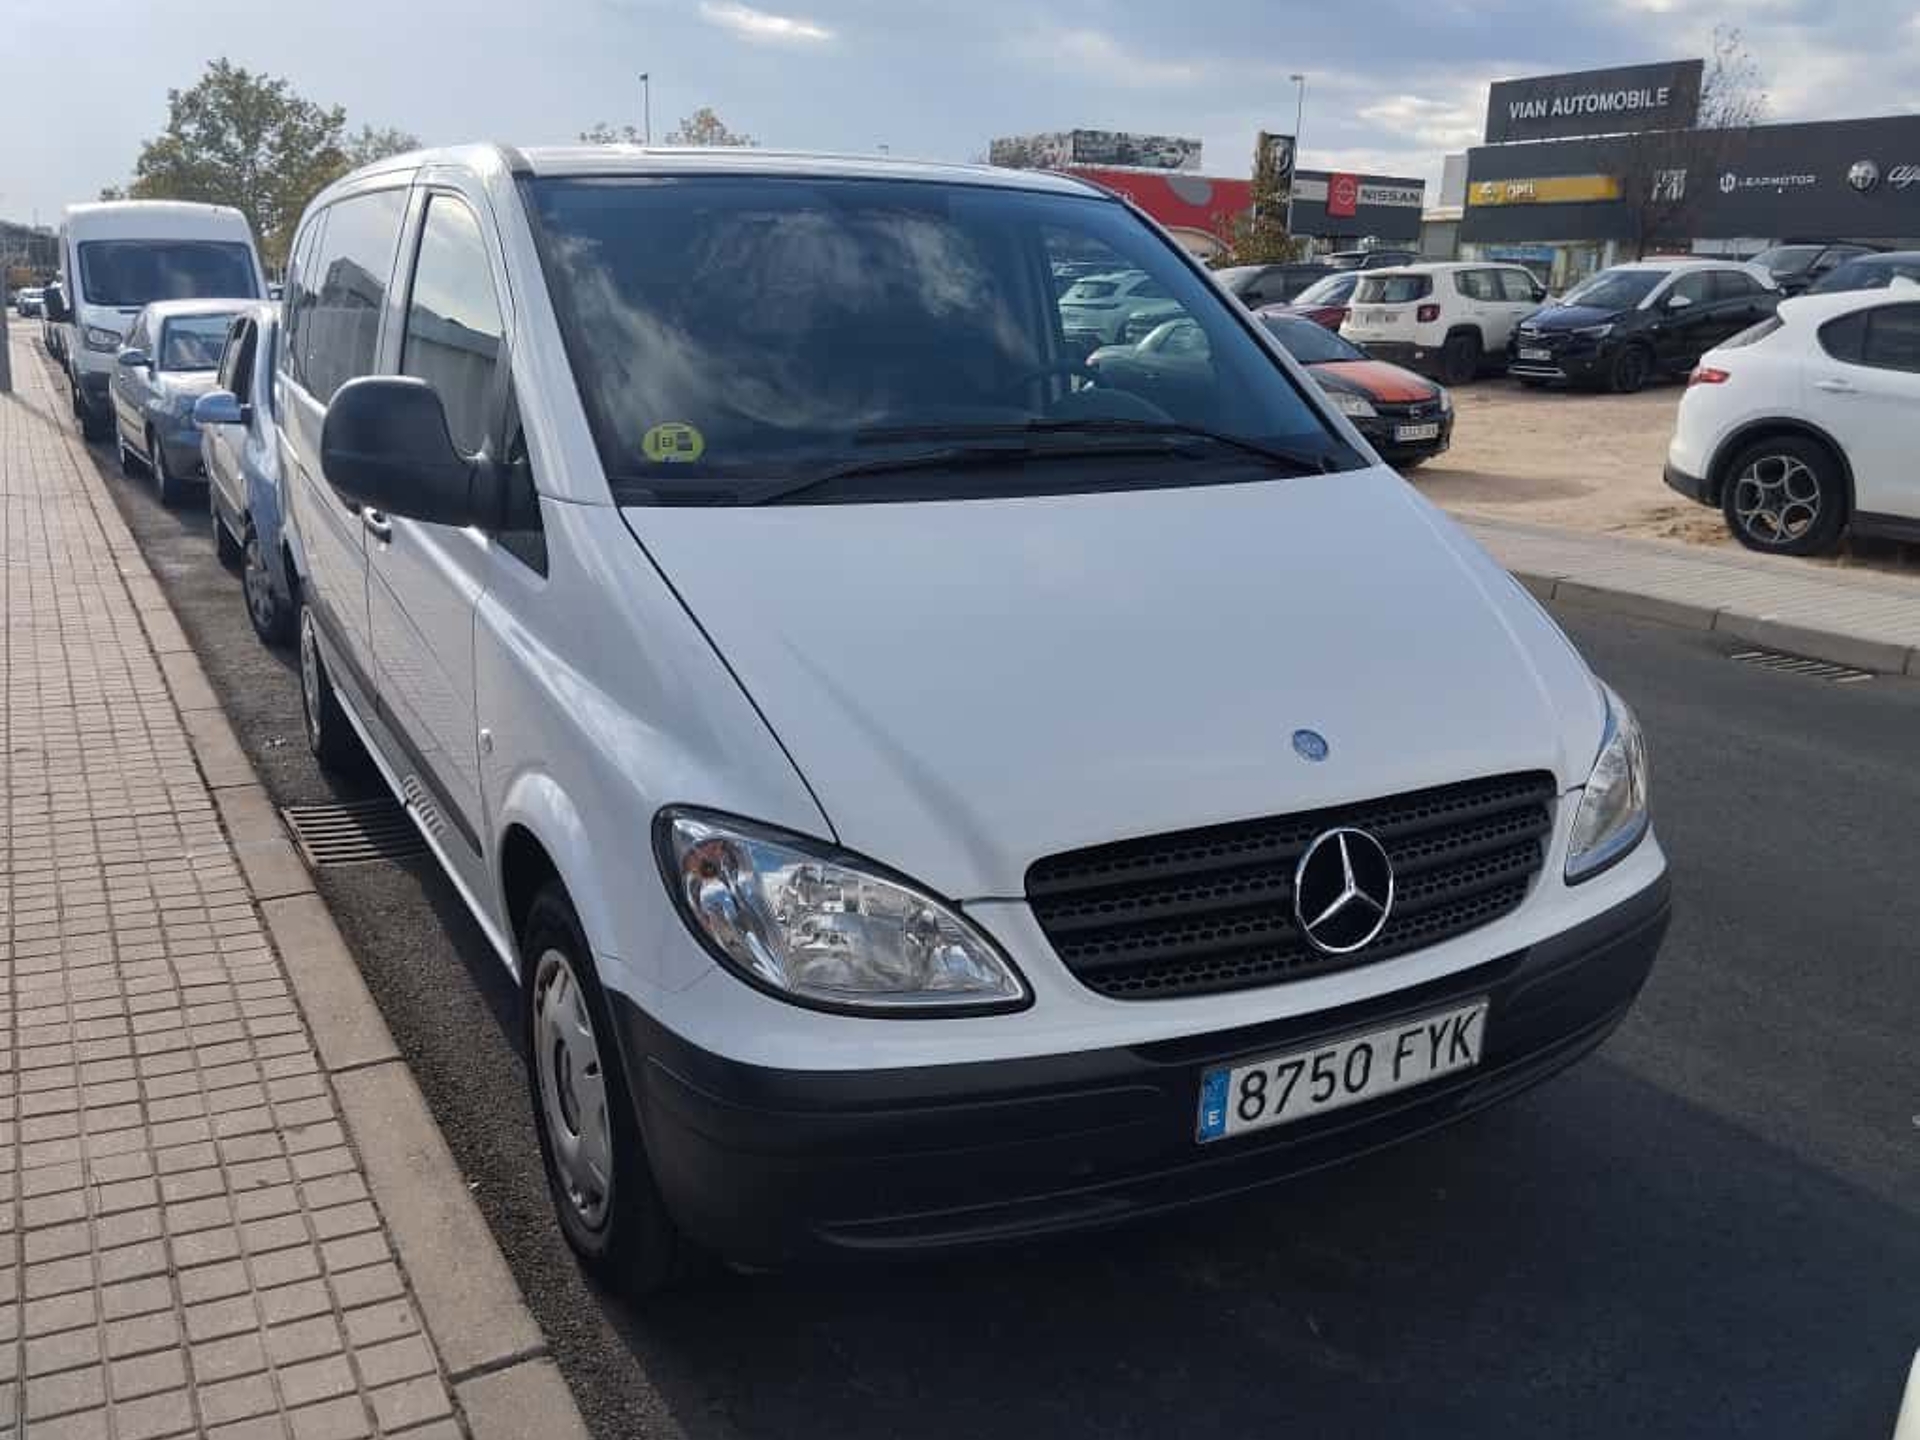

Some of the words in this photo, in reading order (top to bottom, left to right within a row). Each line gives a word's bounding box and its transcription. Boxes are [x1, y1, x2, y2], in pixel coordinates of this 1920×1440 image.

[1509, 99, 1547, 119] VIAN
[1551, 88, 1669, 116] AUTOMOBILE
[1361, 188, 1420, 204] NISSAN
[1236, 1042, 1374, 1122] 8750
[1392, 1010, 1478, 1082] FYK
[1208, 1109, 1220, 1126] E
